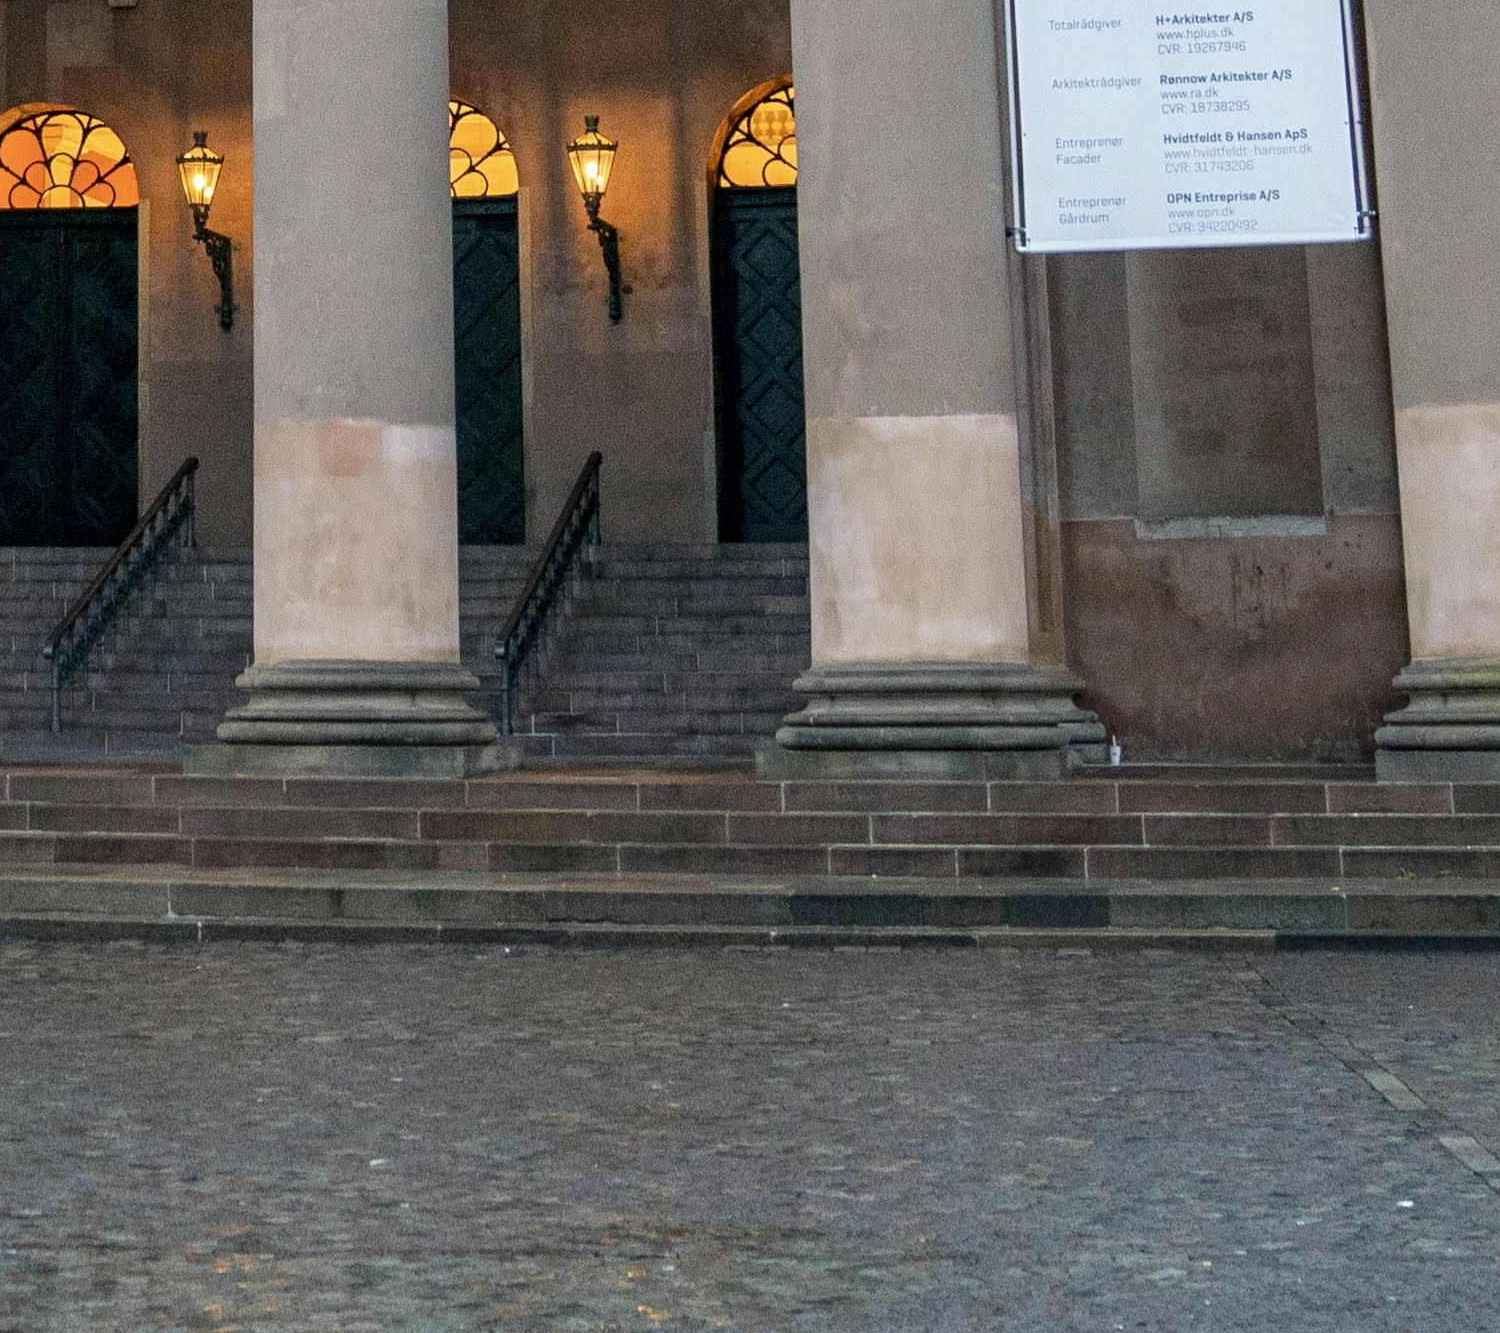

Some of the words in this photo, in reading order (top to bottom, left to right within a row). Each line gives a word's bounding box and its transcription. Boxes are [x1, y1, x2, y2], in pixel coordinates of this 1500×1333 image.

[1048, 18, 1122, 32] Totalrådgiver
[1155, 13, 1230, 26] H+Arkitekter
[1233, 11, 1254, 23] A/S
[1156, 27, 1234, 41] www.hplus.dk
[1160, 73, 1207, 84] Rønnow
[1210, 70, 1268, 82] Arkitekter
[1271, 69, 1292, 81] A/S
[1052, 77, 1142, 90] Arkitektrådgiver
[1160, 88, 1219, 99] www.ra.dk
[1163, 132, 1222, 145] Hvidtfeldt
[1225, 131, 1234, 142] &
[1237, 130, 1282, 142] Hansen
[1284, 128, 1308, 141] ApS
[1055, 137, 1124, 150] Entreprenør
[1056, 153, 1101, 165] Facader
[1058, 196, 1127, 209] Entreprenør
[1166, 192, 1191, 204] OPN
[1195, 190, 1256, 204] Entreprise
[1259, 189, 1280, 202] A/S
[1059, 212, 1109, 225] Gårdrum
